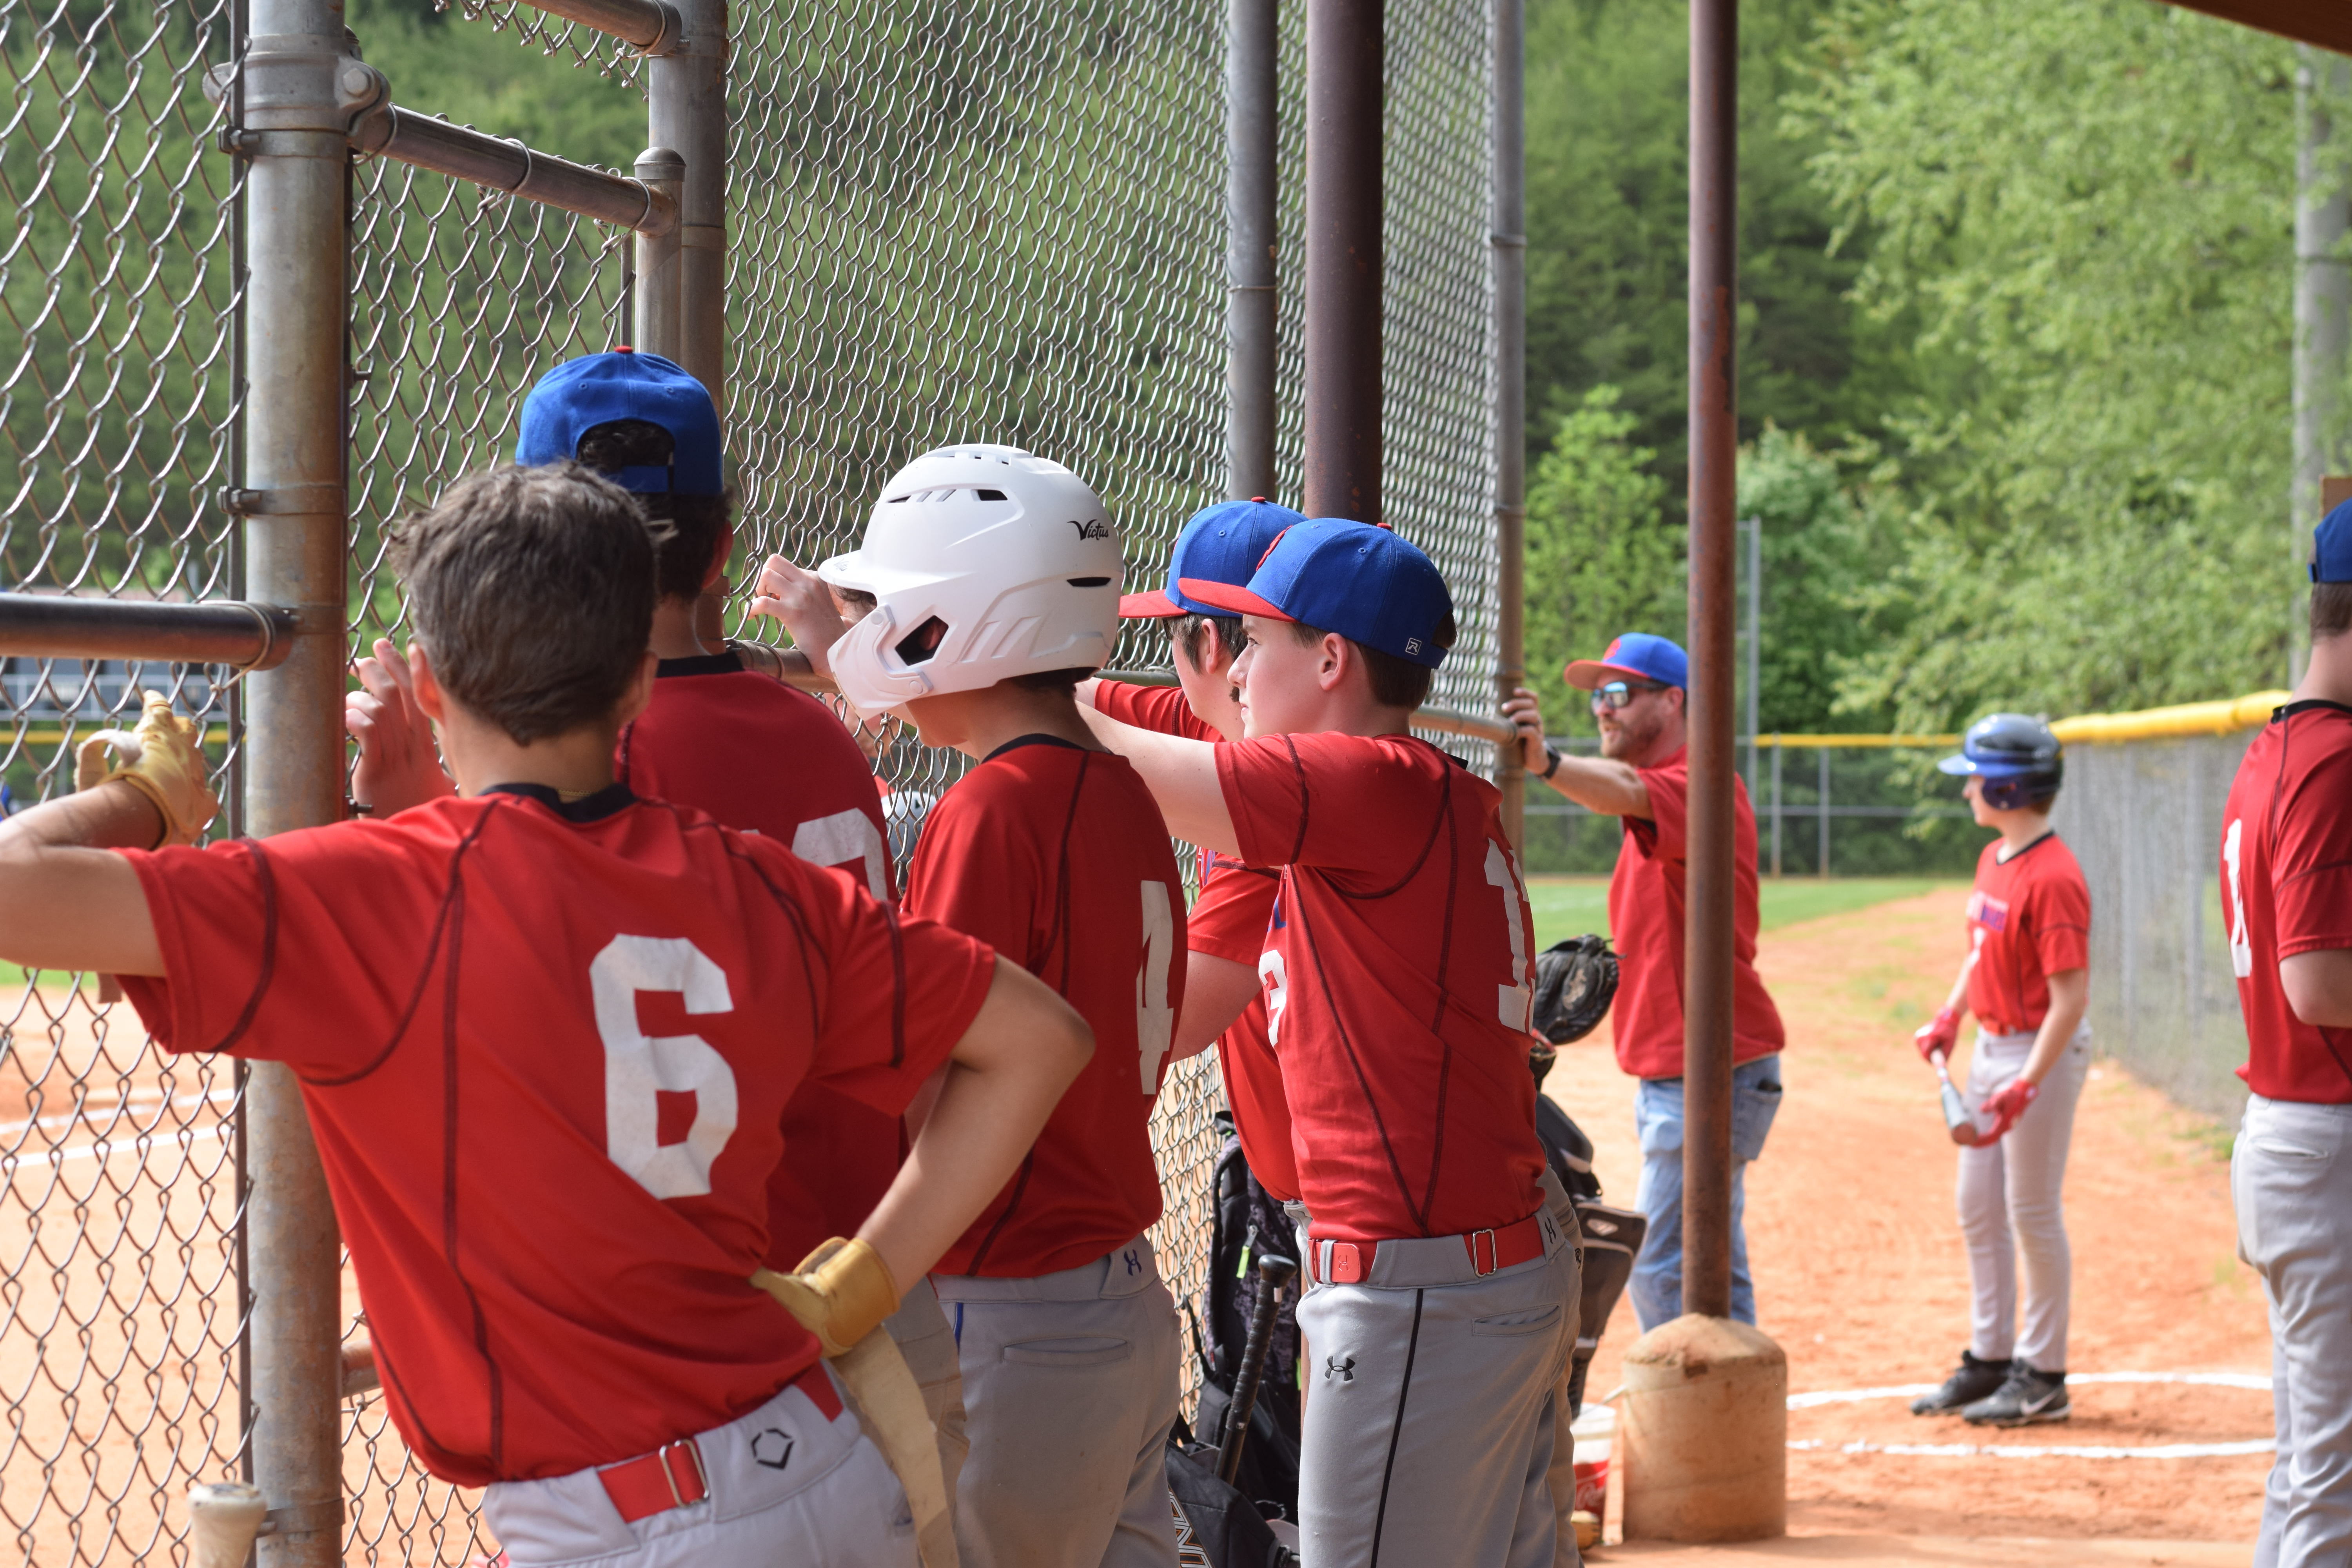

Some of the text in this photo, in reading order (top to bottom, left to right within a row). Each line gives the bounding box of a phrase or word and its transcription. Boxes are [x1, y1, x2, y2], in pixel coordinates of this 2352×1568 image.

[1067, 519, 1109, 541] Victus
[1484, 837, 1535, 1034] 1
[589, 933, 738, 1200] 6
